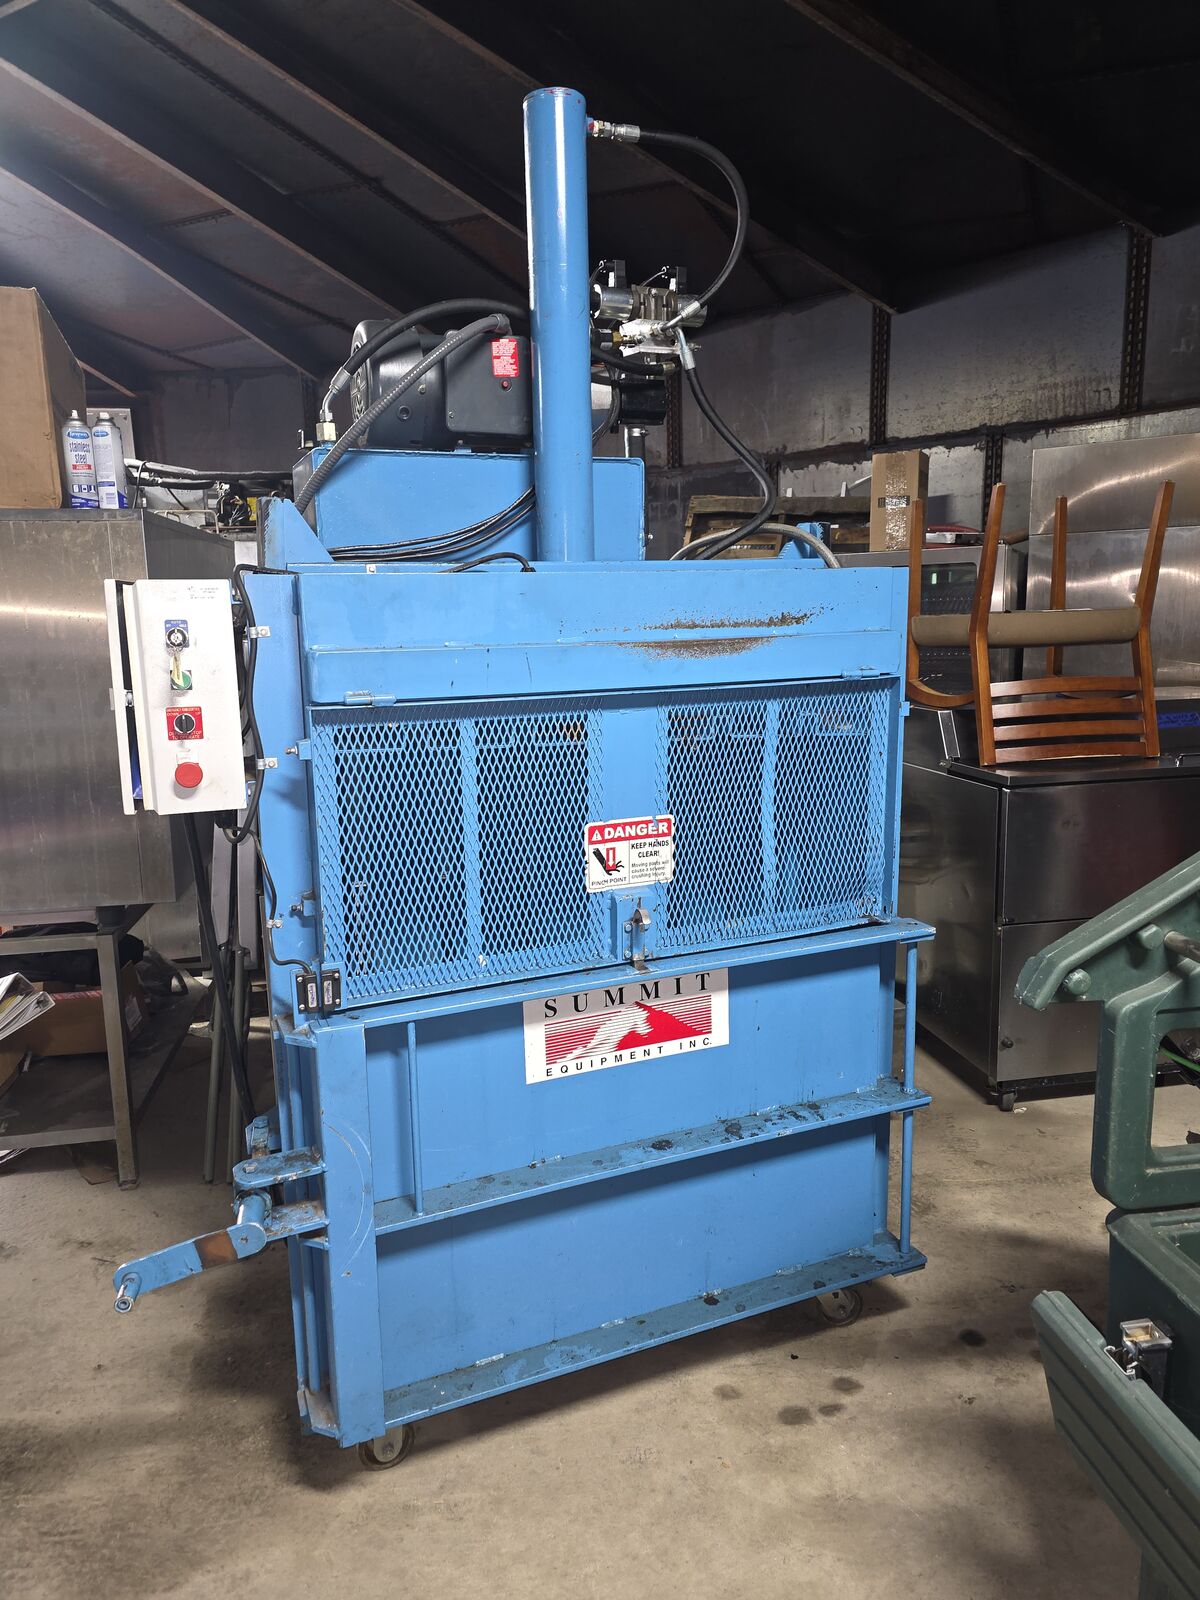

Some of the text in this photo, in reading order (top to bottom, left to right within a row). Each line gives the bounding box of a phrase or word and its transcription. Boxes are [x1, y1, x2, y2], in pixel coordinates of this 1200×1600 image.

[74, 453, 87, 464] steel
[604, 822, 669, 840] DANGER
[631, 839, 670, 850] KEEP HANDS
[638, 850, 660, 858] CLEAR!
[631, 861, 648, 869] Moving
[631, 871, 652, 880] crushing
[591, 876, 627, 887] PINCH POINT
[544, 972, 711, 1019] SUMMIT
[546, 1037, 712, 1077] EQUIPMENT INC.
